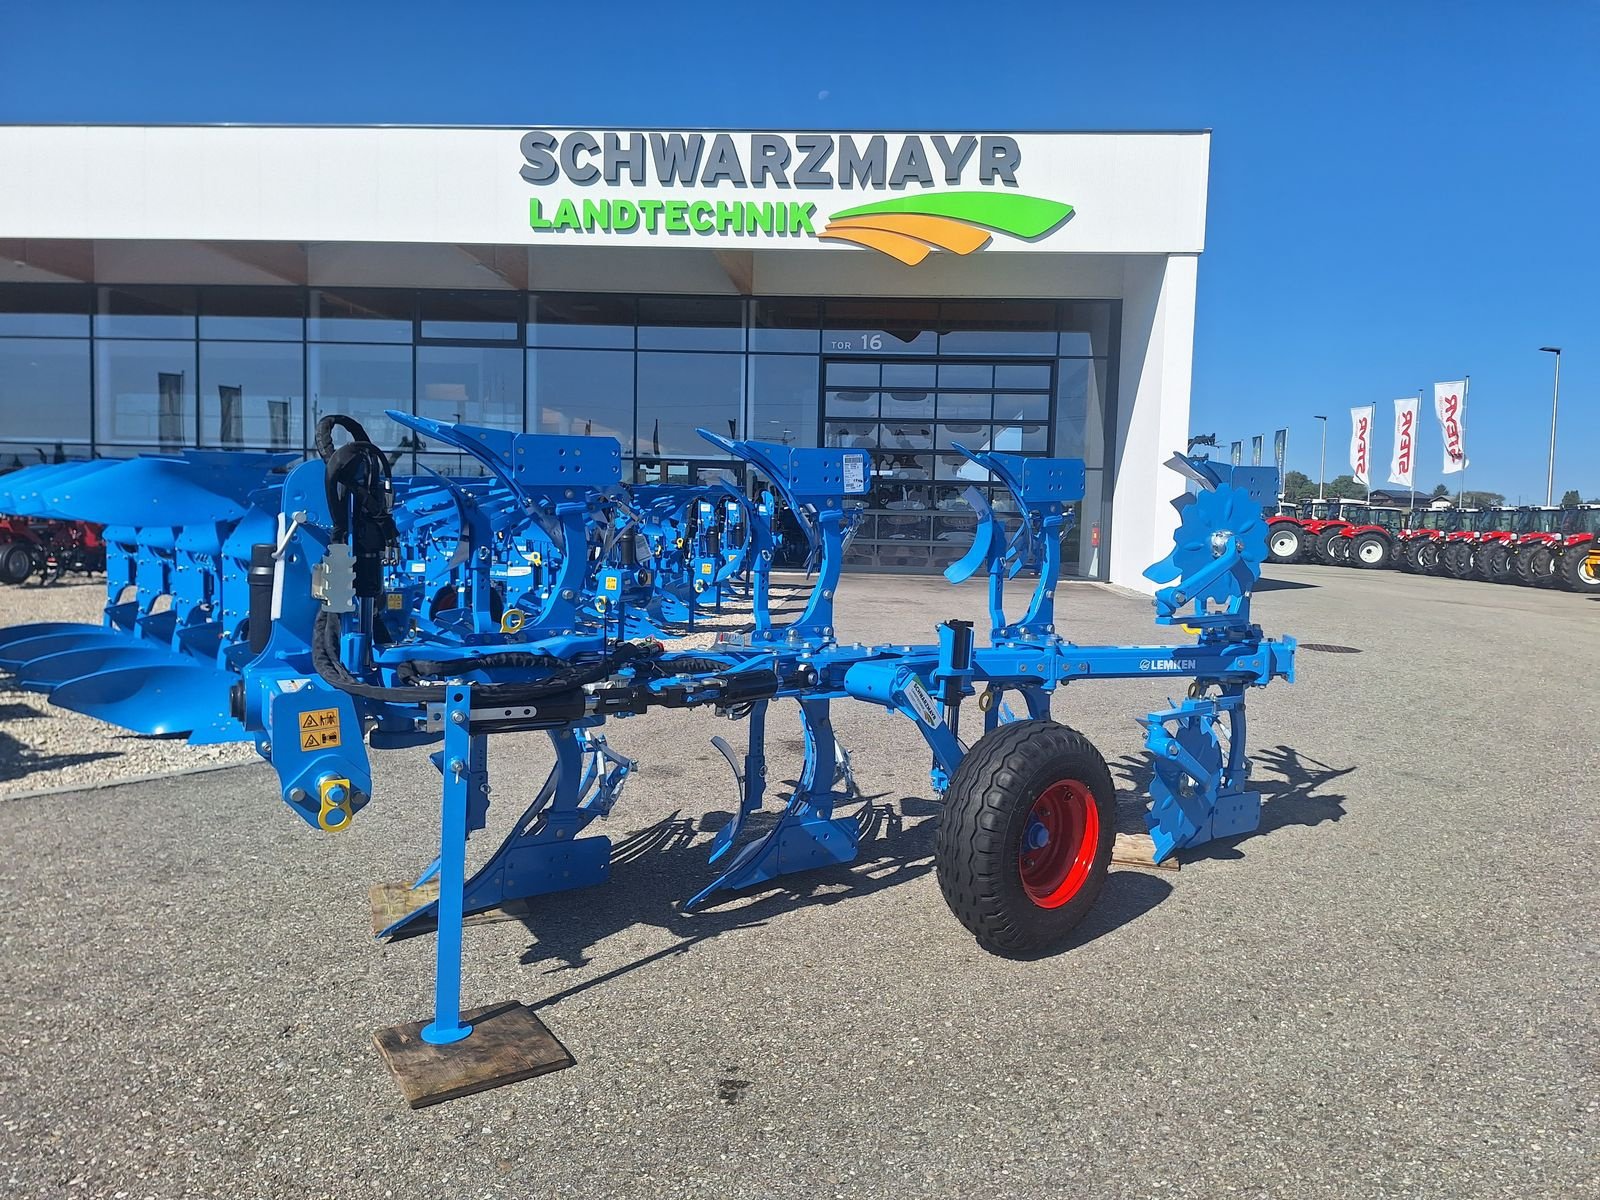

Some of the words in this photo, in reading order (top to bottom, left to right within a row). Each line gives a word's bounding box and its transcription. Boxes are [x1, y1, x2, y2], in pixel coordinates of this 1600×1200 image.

[519, 131, 1021, 190] SCHWARZMAYR
[529, 197, 817, 236] LANDTECHNIK
[831, 341, 851, 350] TOR
[861, 334, 882, 350] 16
[1151, 659, 1196, 670] LEMKEN
[913, 683, 937, 720] SCHWARZMAYR
